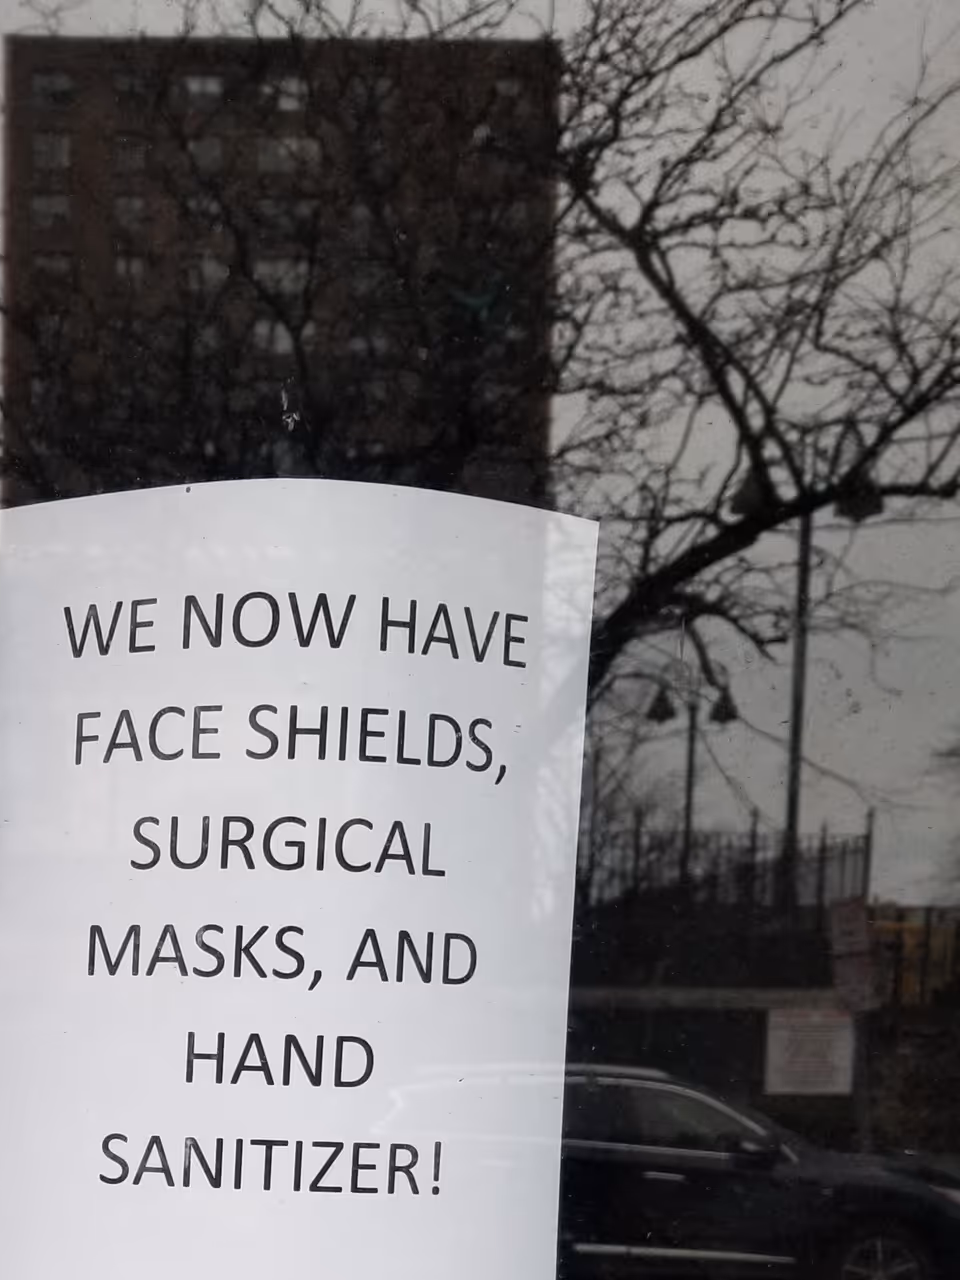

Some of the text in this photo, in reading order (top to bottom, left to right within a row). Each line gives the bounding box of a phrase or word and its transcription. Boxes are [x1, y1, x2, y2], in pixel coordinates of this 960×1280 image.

[63, 591, 529, 669] WE NOW HAVE
[75, 704, 507, 786] FACE SHIELDS,
[130, 815, 446, 877] SURGICAL
[87, 923, 478, 991] MASKS, AND
[185, 1031, 374, 1088] HAND
[99, 1133, 442, 1196] SANITIZER!
